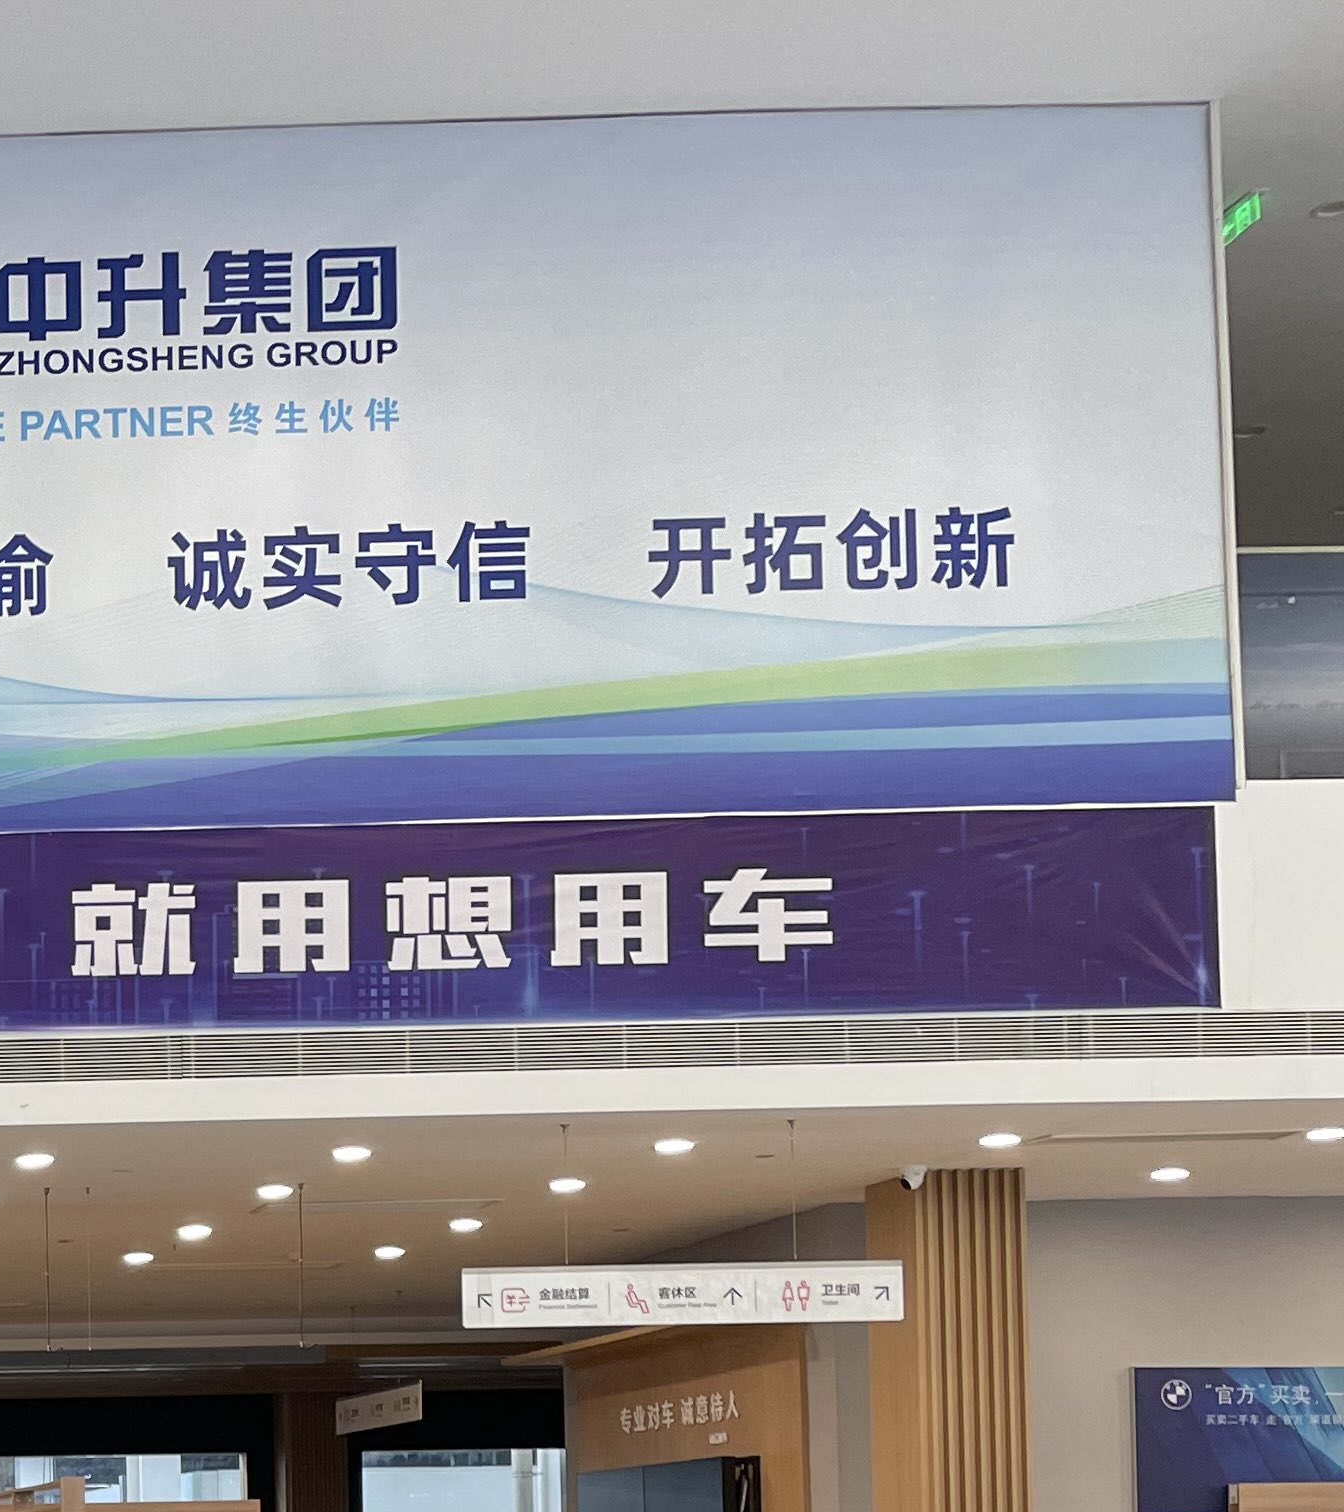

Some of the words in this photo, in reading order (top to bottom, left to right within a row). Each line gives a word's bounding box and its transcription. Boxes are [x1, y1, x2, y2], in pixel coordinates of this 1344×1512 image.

[266, 339, 399, 368] GROUP
[20, 404, 214, 441] PARTNER
[228, 397, 401, 436] 终生伙伴
[166, 520, 532, 611] 诚实守信
[647, 506, 1017, 598] 开拓创新
[539, 1287, 590, 1300] 金融结算
[821, 1283, 860, 1296] 卫生间
